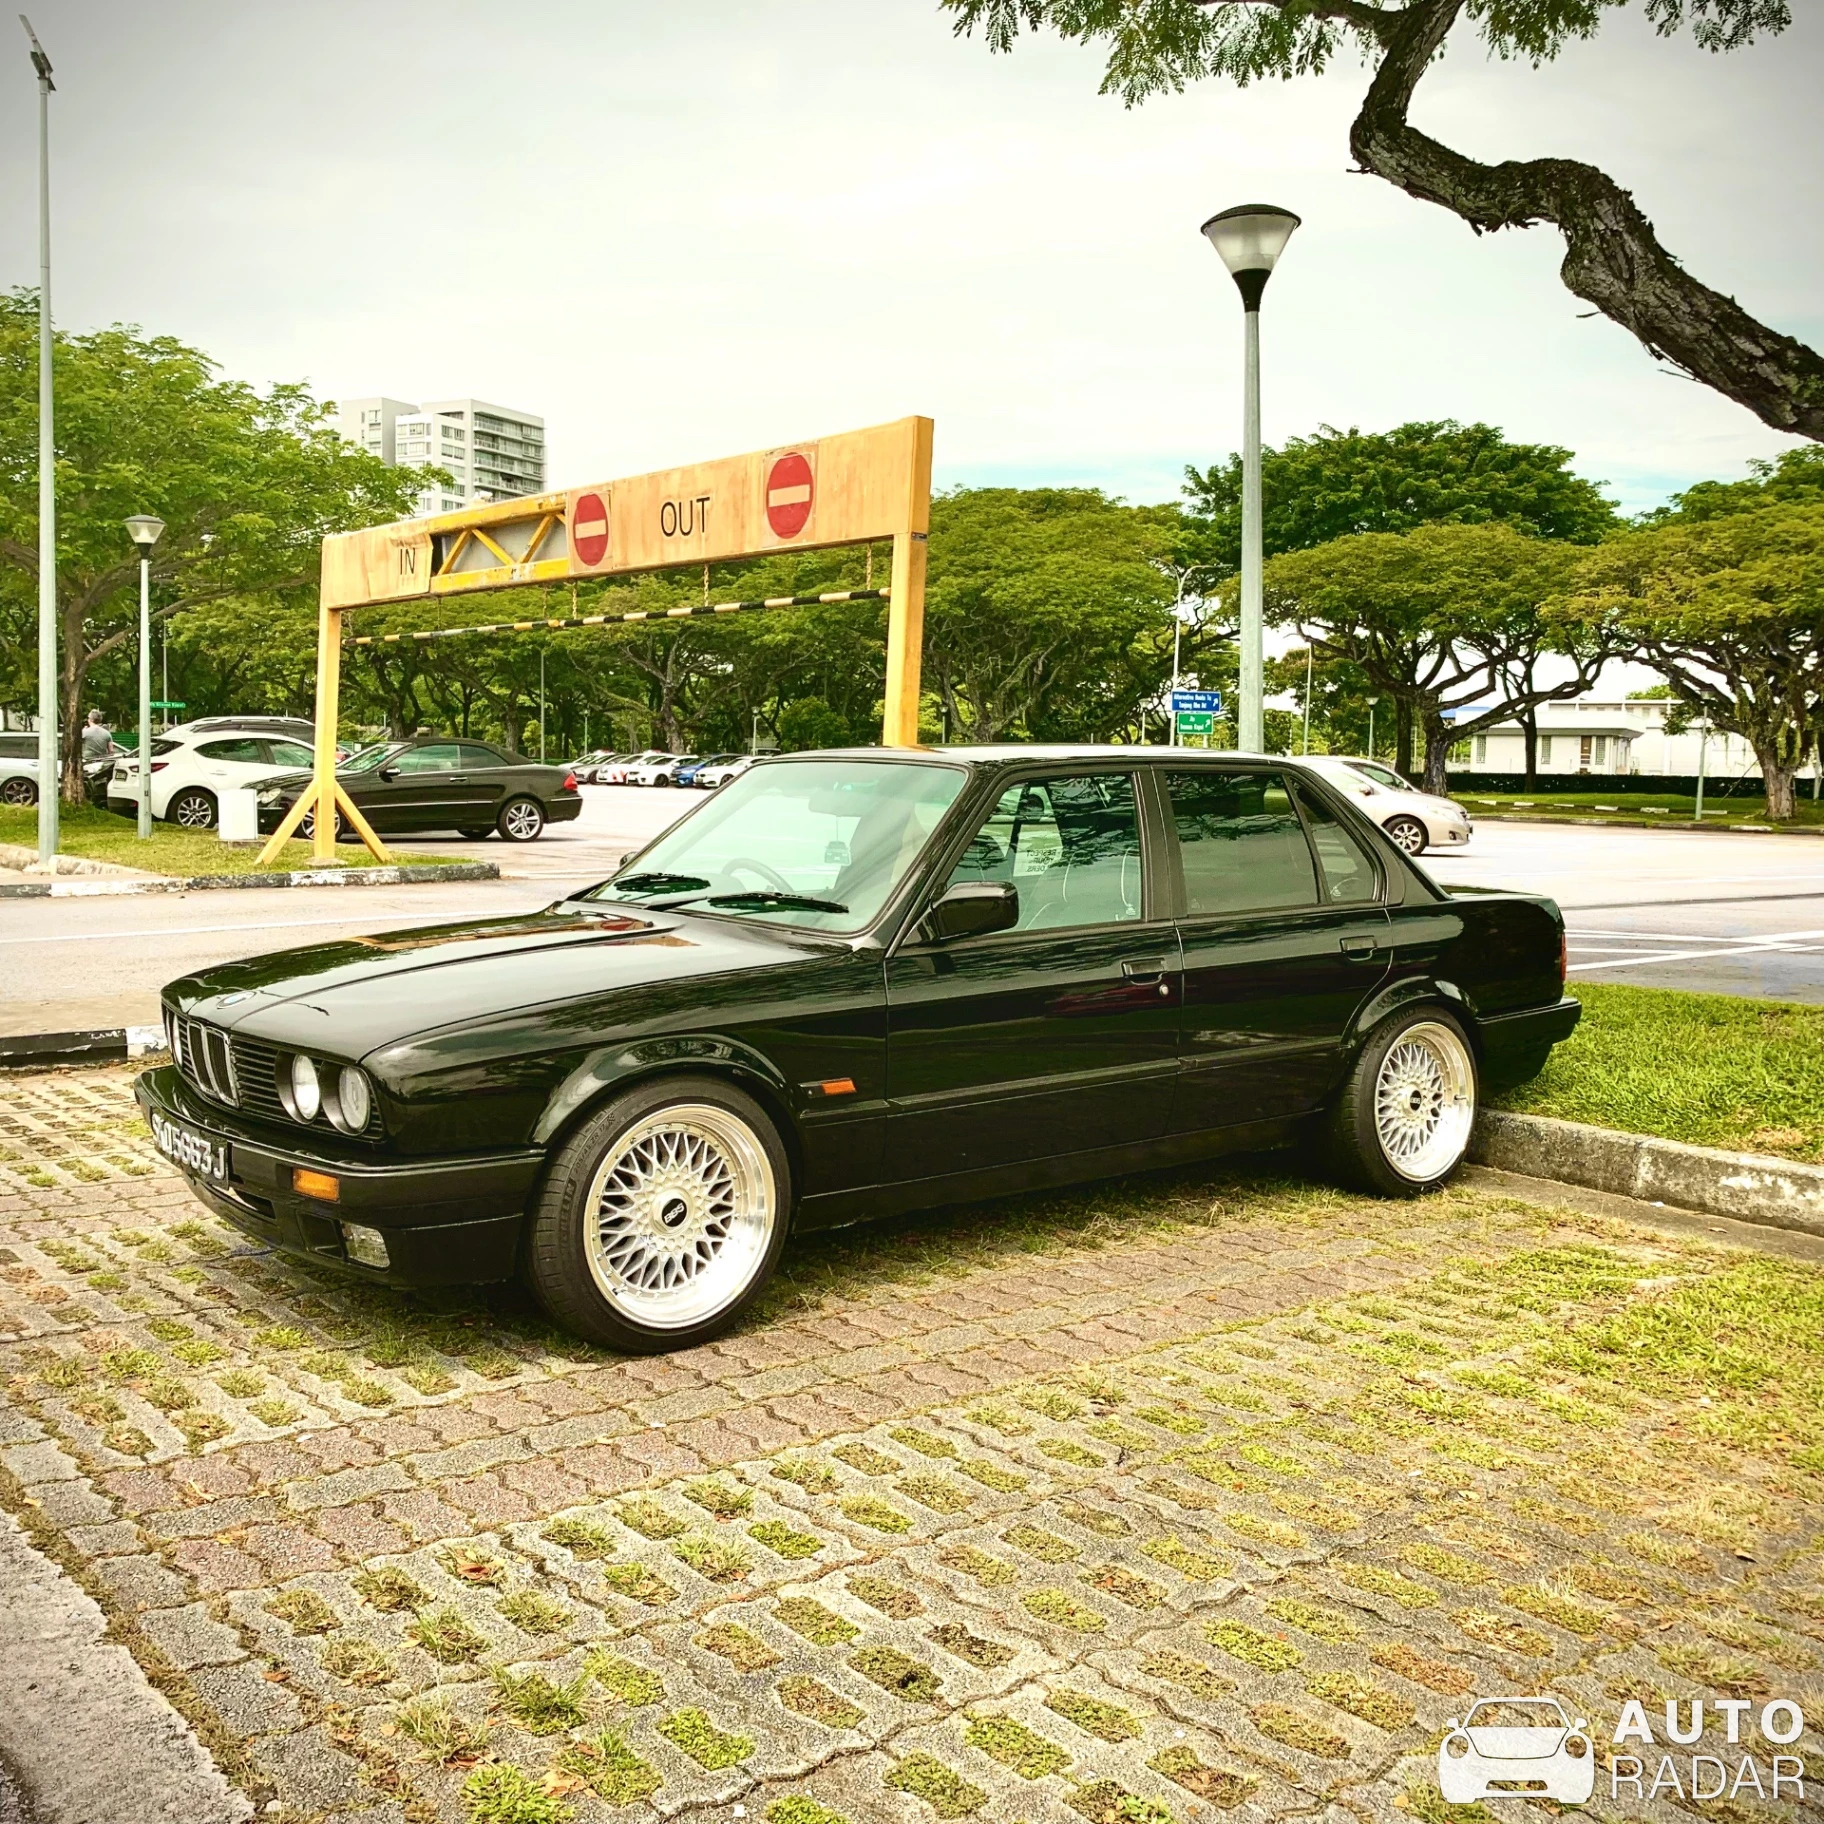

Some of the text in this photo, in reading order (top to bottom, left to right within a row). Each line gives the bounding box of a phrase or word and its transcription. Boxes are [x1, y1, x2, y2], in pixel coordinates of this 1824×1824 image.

[661, 497, 710, 537] OUT
[400, 547, 415, 575] IN
[664, 1202, 685, 1224] BBS
